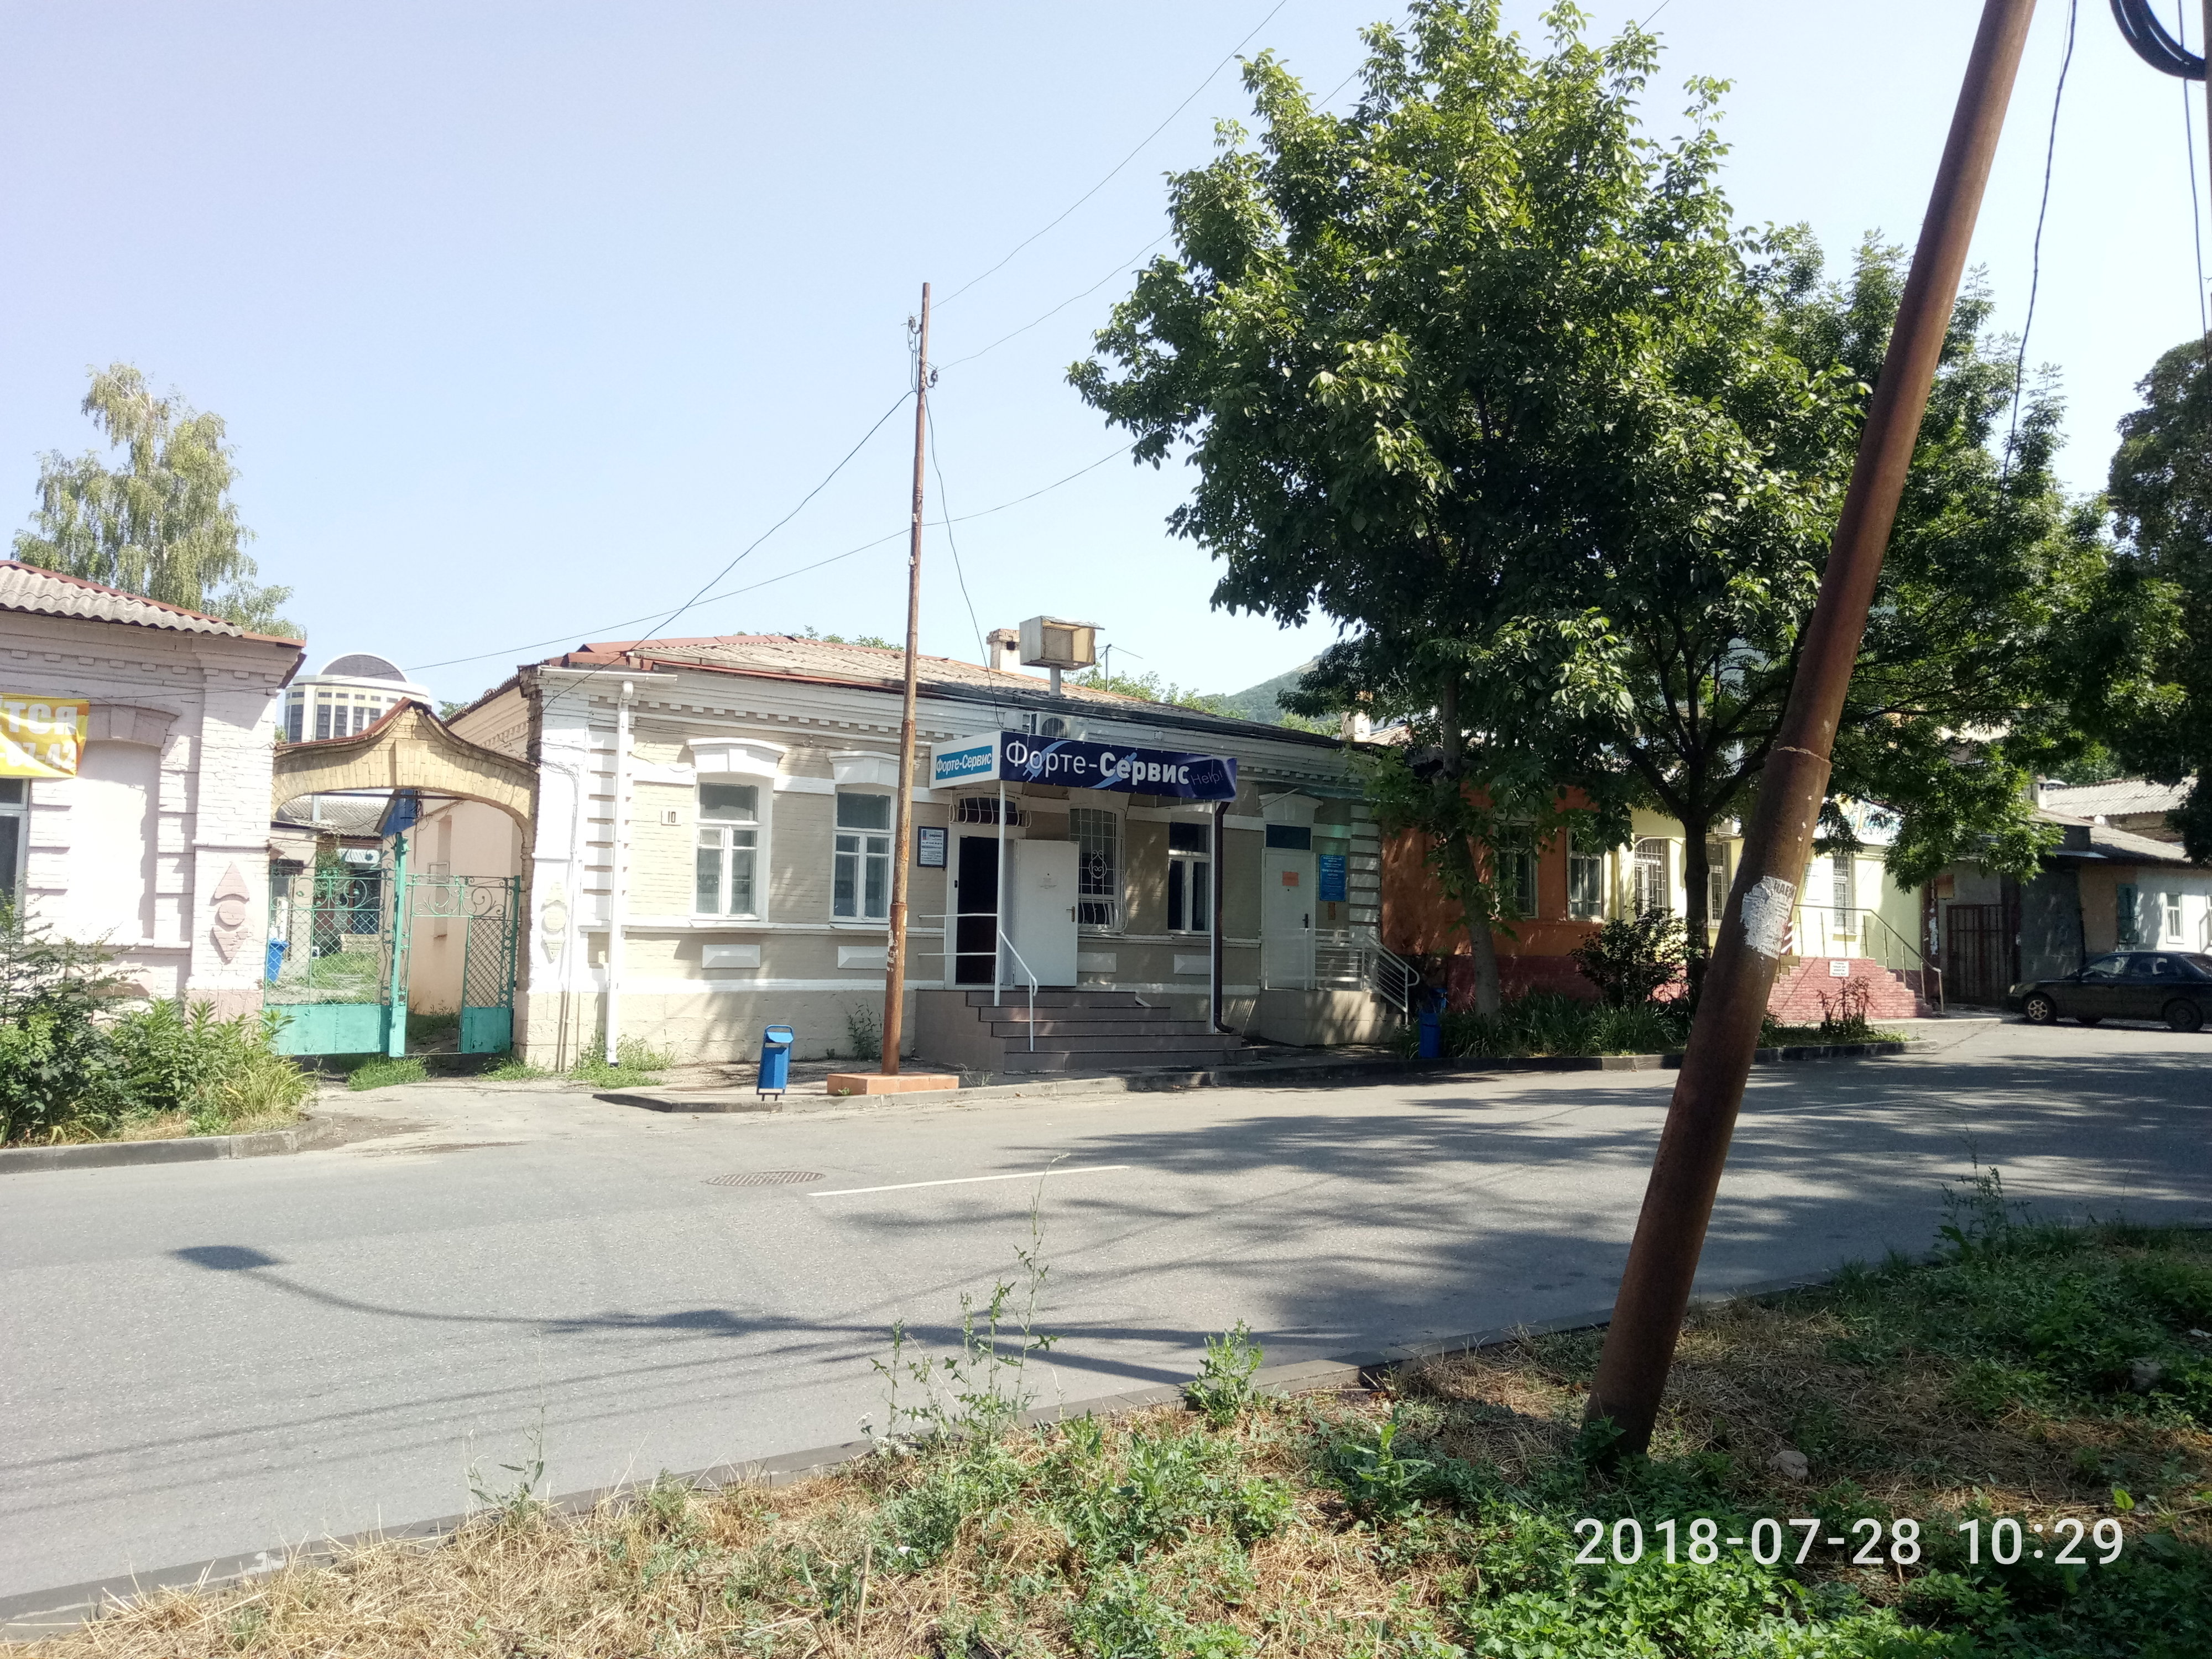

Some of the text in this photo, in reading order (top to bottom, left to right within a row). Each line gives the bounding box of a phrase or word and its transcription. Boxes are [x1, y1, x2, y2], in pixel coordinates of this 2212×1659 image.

[0, 695, 77, 734] ТСЯ
[936, 753, 992, 775] Форте-Сервис
[1006, 740, 1190, 785] Форте-Сервис
[1190, 770, 1223, 785] Help!
[667, 811, 676, 823] 10
